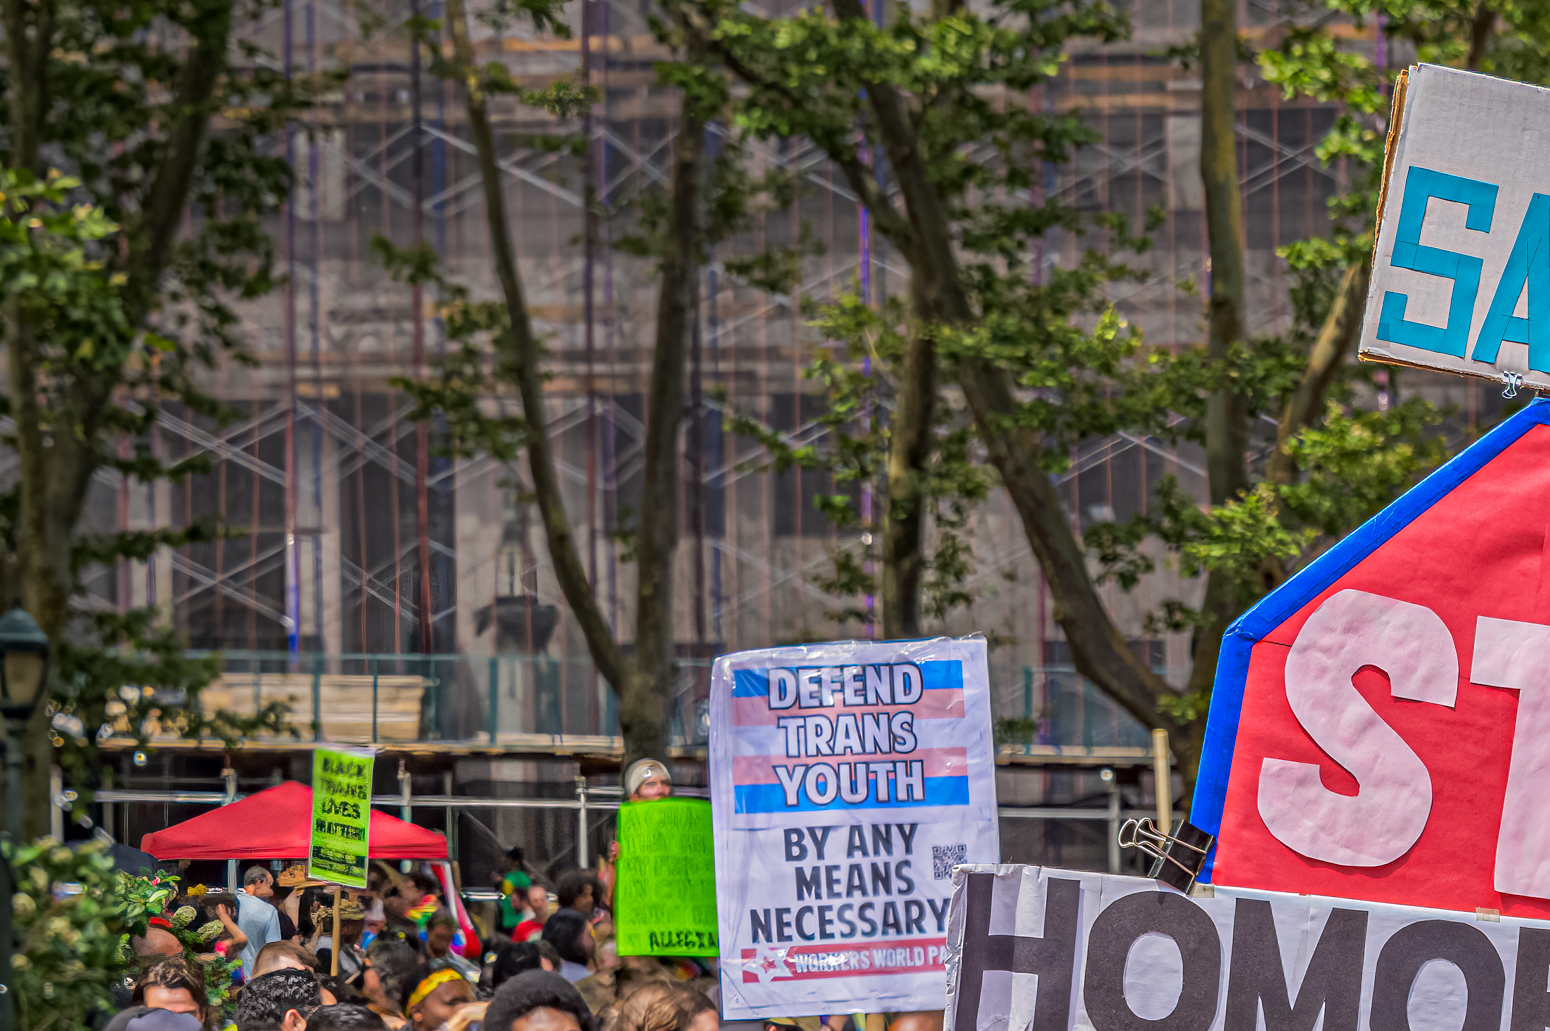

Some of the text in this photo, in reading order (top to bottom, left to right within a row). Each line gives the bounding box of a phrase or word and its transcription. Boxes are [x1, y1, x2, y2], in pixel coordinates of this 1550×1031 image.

[767, 661, 924, 710] DEFEND
[777, 711, 918, 758] TRANS
[774, 759, 925, 807] YOUTH
[783, 823, 918, 862] BY ANY
[795, 860, 915, 901] MEANS
[749, 897, 952, 944] NECESSARY
[873, 945, 925, 968] WORLD
